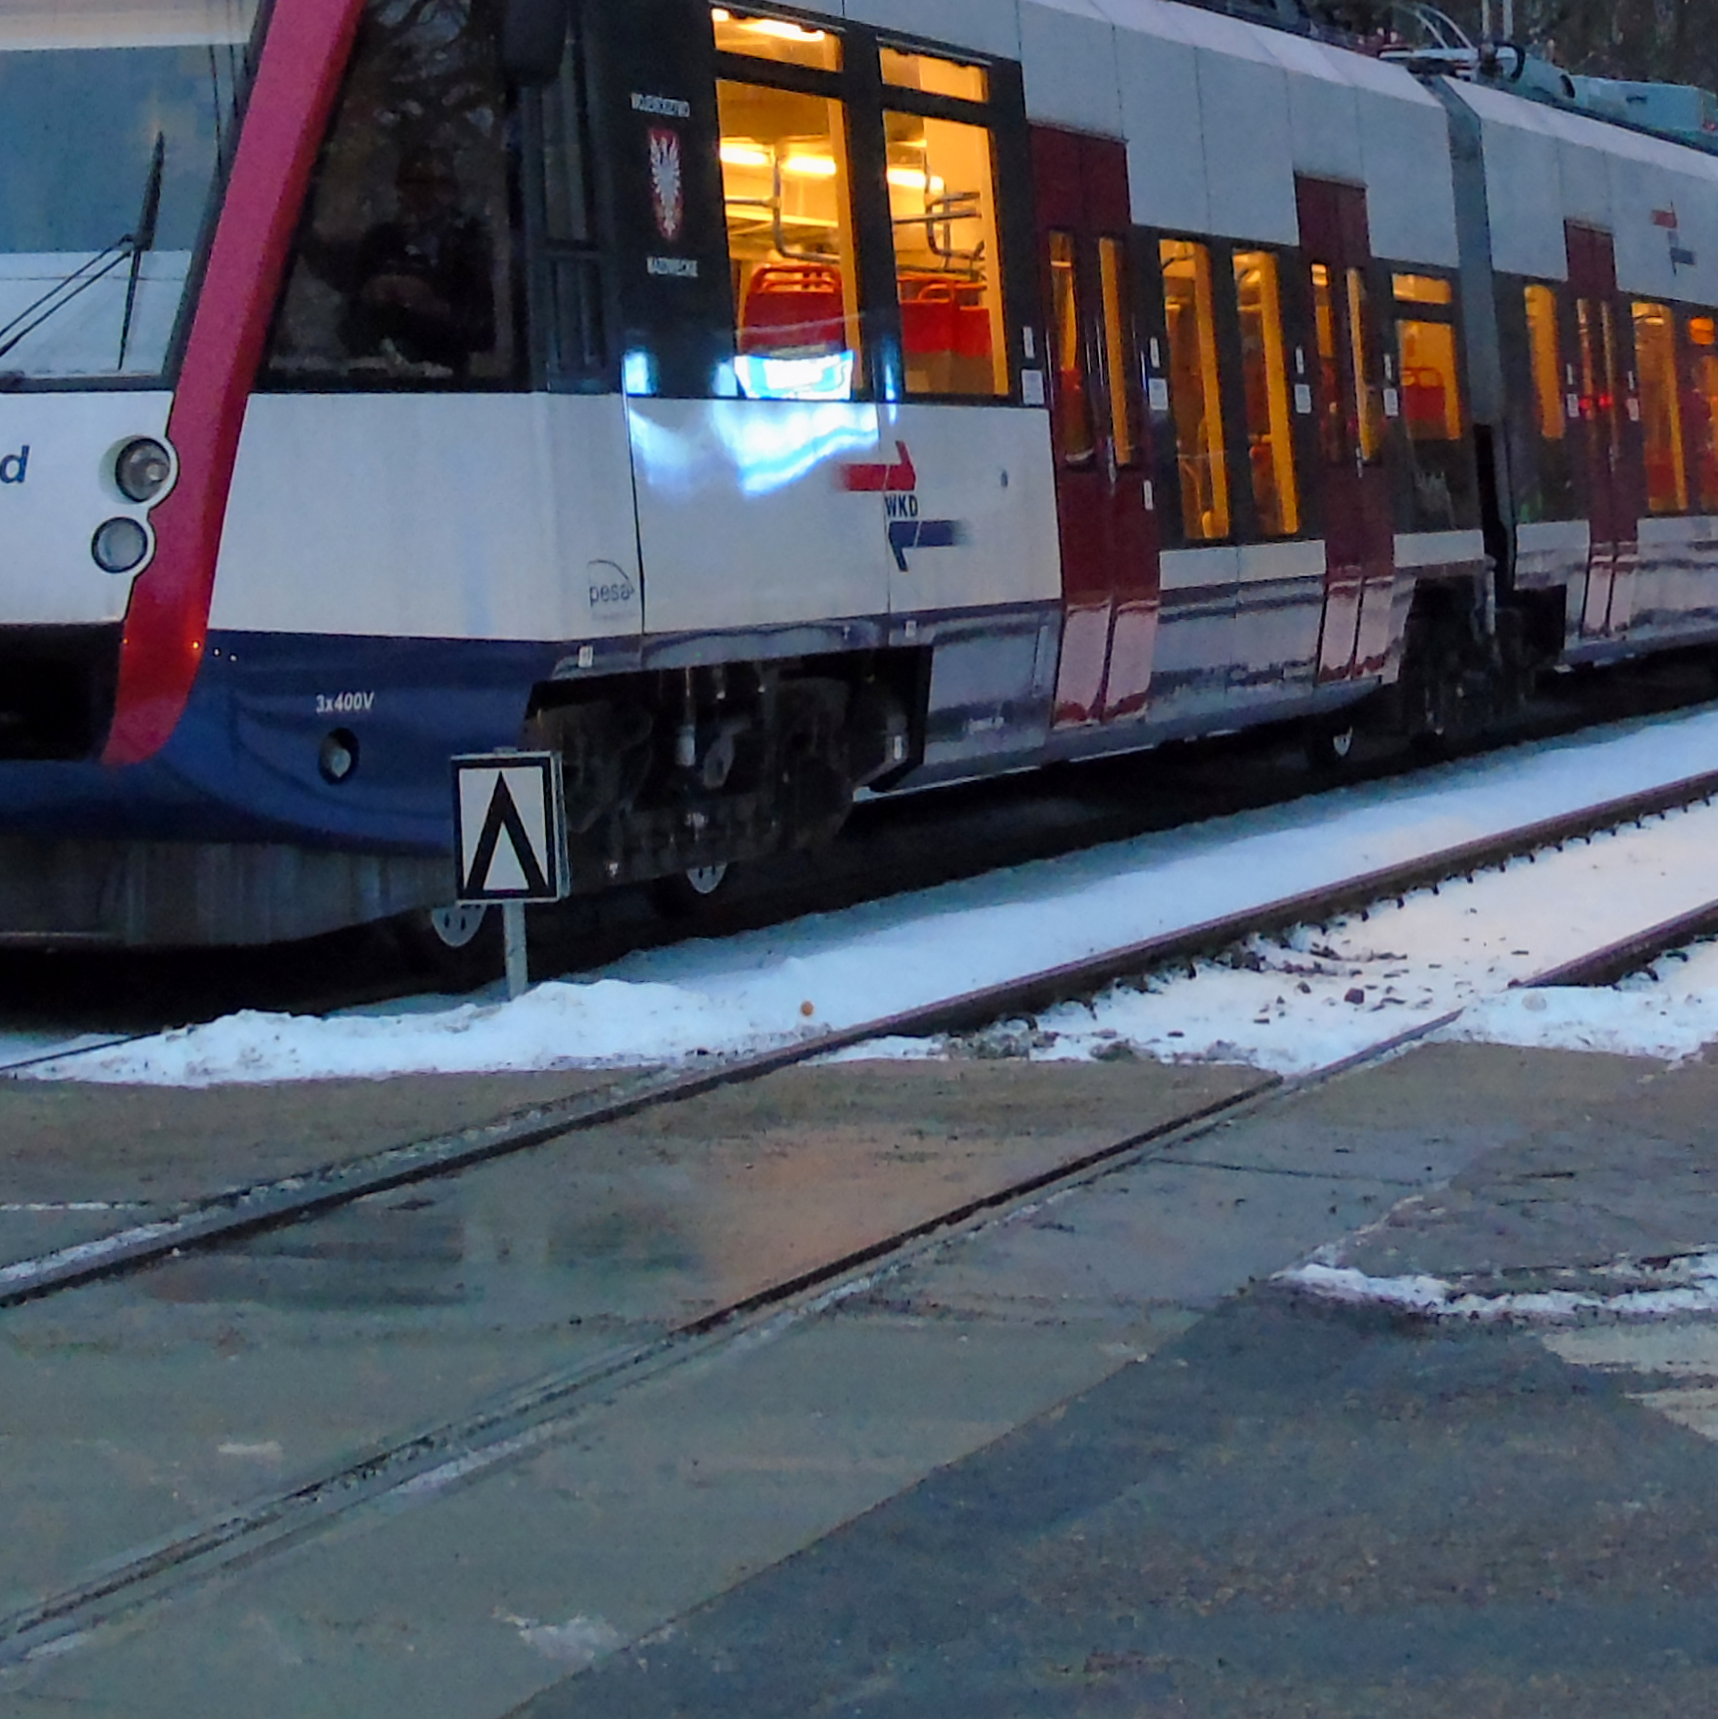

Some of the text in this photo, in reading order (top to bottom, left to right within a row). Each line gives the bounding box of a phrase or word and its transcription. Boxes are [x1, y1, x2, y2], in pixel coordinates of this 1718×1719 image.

[884, 493, 919, 518] WKD
[589, 584, 630, 607] pesa
[315, 690, 375, 714] 3x400V
